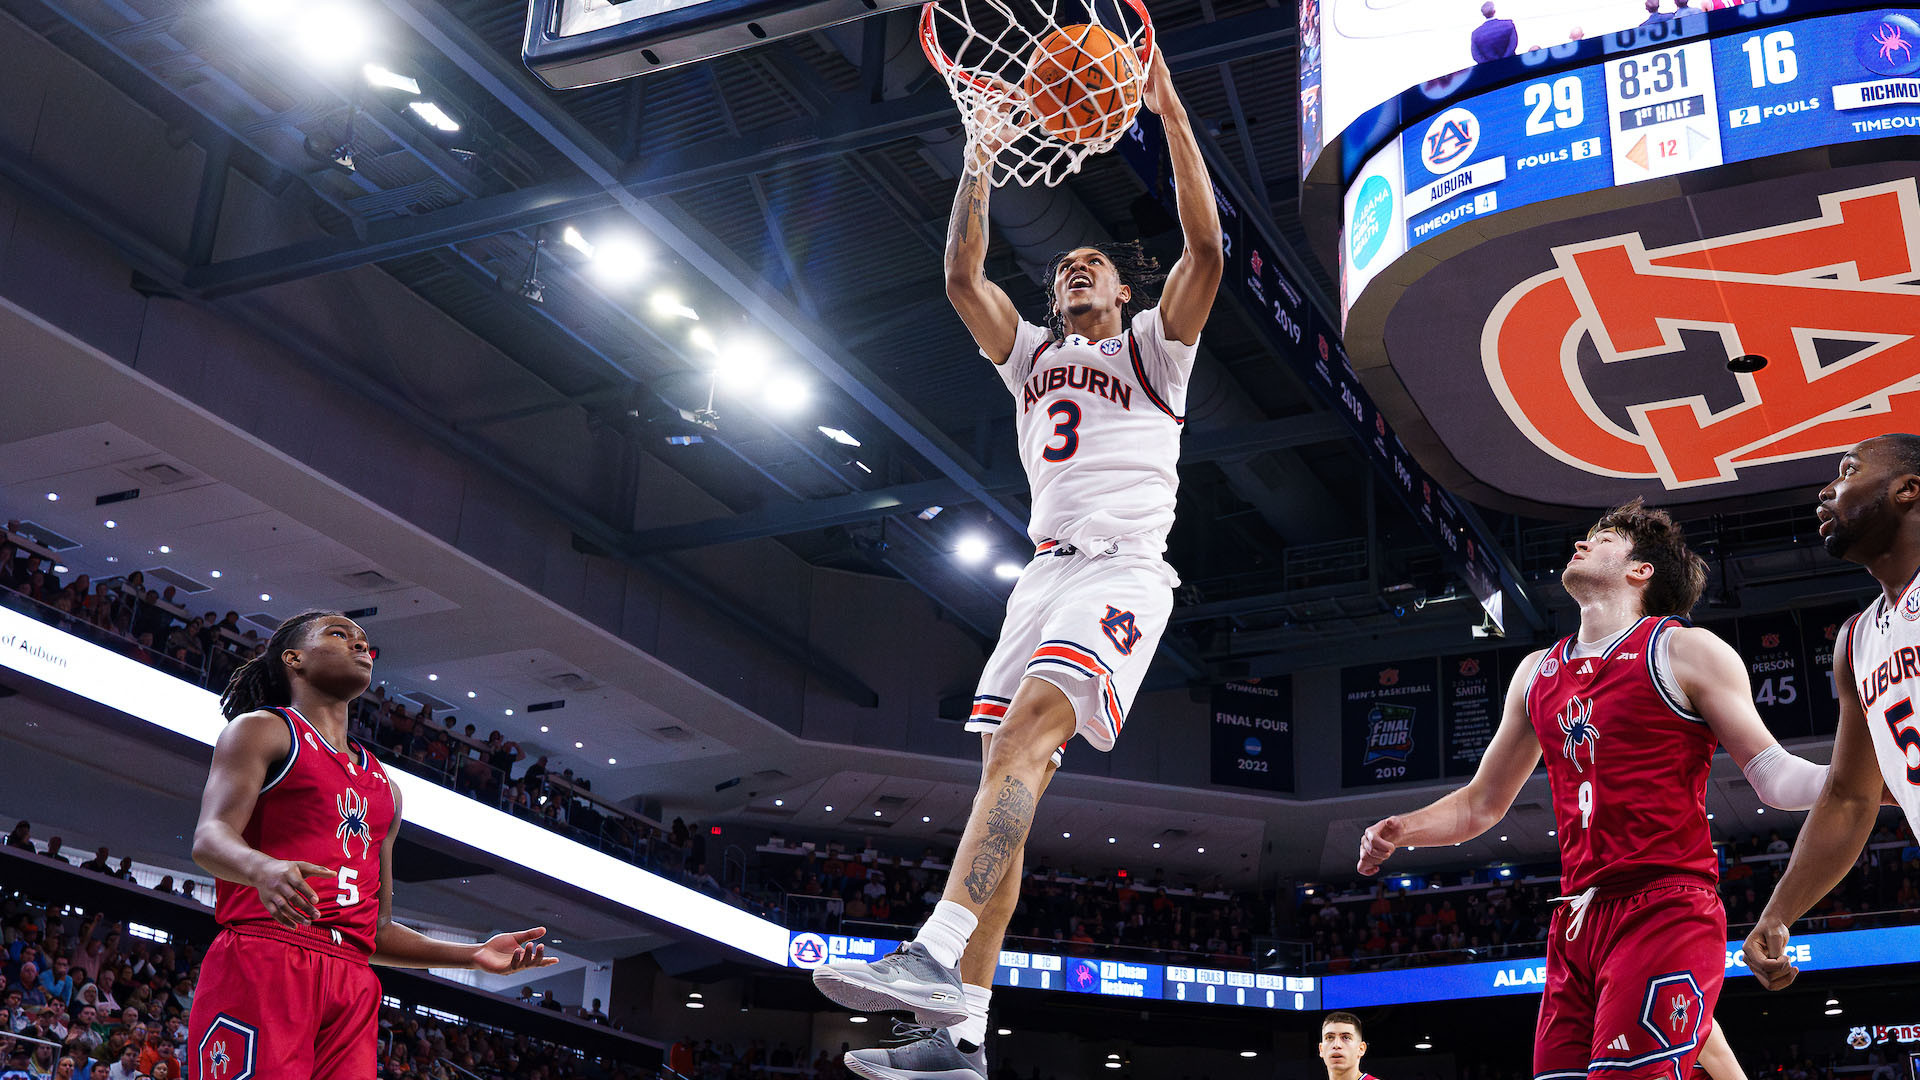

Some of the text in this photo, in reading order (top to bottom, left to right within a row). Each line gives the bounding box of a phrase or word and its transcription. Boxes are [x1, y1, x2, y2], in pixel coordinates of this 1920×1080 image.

[1618, 48, 1689, 100] 8:31
[1742, 30, 1798, 89] 16
[1524, 76, 1584, 136] 29
[1861, 83, 1920, 101] RICHMO
[1634, 100, 1691, 126] 1ST HALF
[1740, 98, 1820, 125] 2 FOULS
[1517, 141, 1591, 170] FOULS 3
[1658, 139, 1677, 158] 12
[1430, 170, 1473, 202] AUBURN
[1353, 187, 1389, 233] ALABAMA
[1414, 196, 1490, 237] TIMEOUTS 4
[1274, 300, 1301, 344] 2019
[1024, 365, 1132, 414] AUBURN
[1341, 382, 1363, 422] 2018
[1042, 399, 1081, 463] 3
[2, 635, 66, 668] of Auburn
[1753, 658, 1794, 673] PERSON
[1815, 654, 1834, 664] PER
[1226, 682, 1278, 696] GYMNASTICS
[1348, 684, 1431, 700] MEN'S BASKETBALL
[1456, 685, 1486, 697] SMITH
[1756, 675, 1797, 706] 45
[1858, 646, 1920, 715] UBUR
[1216, 712, 1288, 732] FINAL FOUR
[1374, 720, 1409, 734] FINAL
[1370, 732, 1408, 747] FOUR
[1884, 696, 1920, 786] 5
[1238, 759, 1268, 772] 2022
[1376, 766, 1406, 779] 2019
[1579, 781, 1593, 829] 9
[337, 866, 360, 907] 5
[1175, 969, 1187, 980] PTS
[1200, 971, 1221, 983] FOULS
[1176, 982, 1186, 1000] 3
[1206, 985, 1215, 1003] 0
